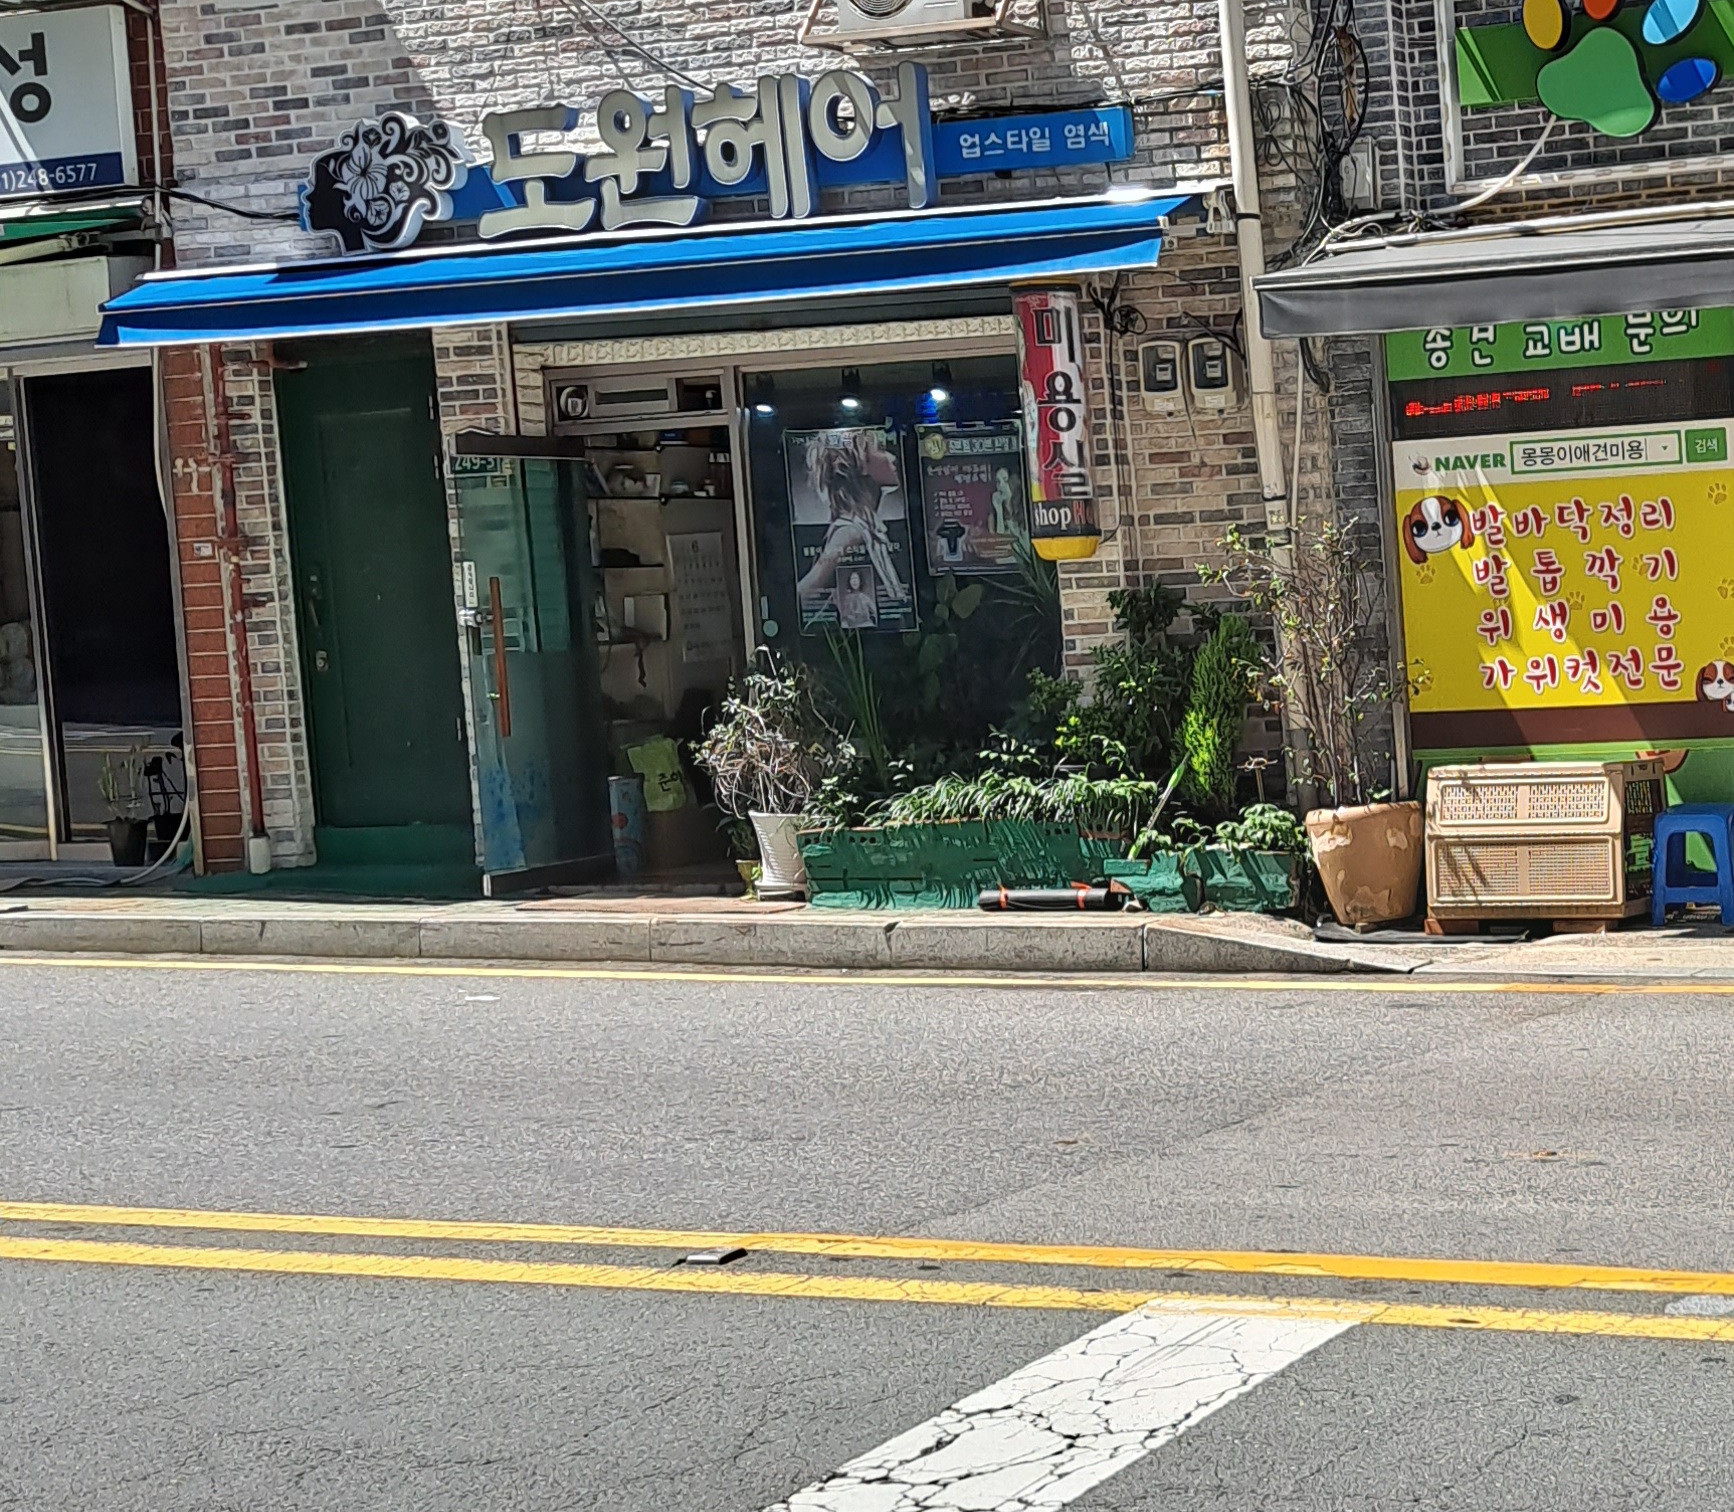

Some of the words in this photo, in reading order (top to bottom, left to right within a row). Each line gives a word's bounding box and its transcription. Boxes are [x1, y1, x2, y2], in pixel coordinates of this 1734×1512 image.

[478, 60, 932, 240] 도원헤어
[959, 127, 1051, 159] 업스타일
[1063, 121, 1110, 150] 염색
[1522, 319, 1602, 359] 교배
[1032, 303, 1094, 500] 미용실
[1434, 452, 1506, 472] NAVER
[1520, 438, 1645, 467] 몽몽이애견미용
[1694, 437, 1718, 454] 검색
